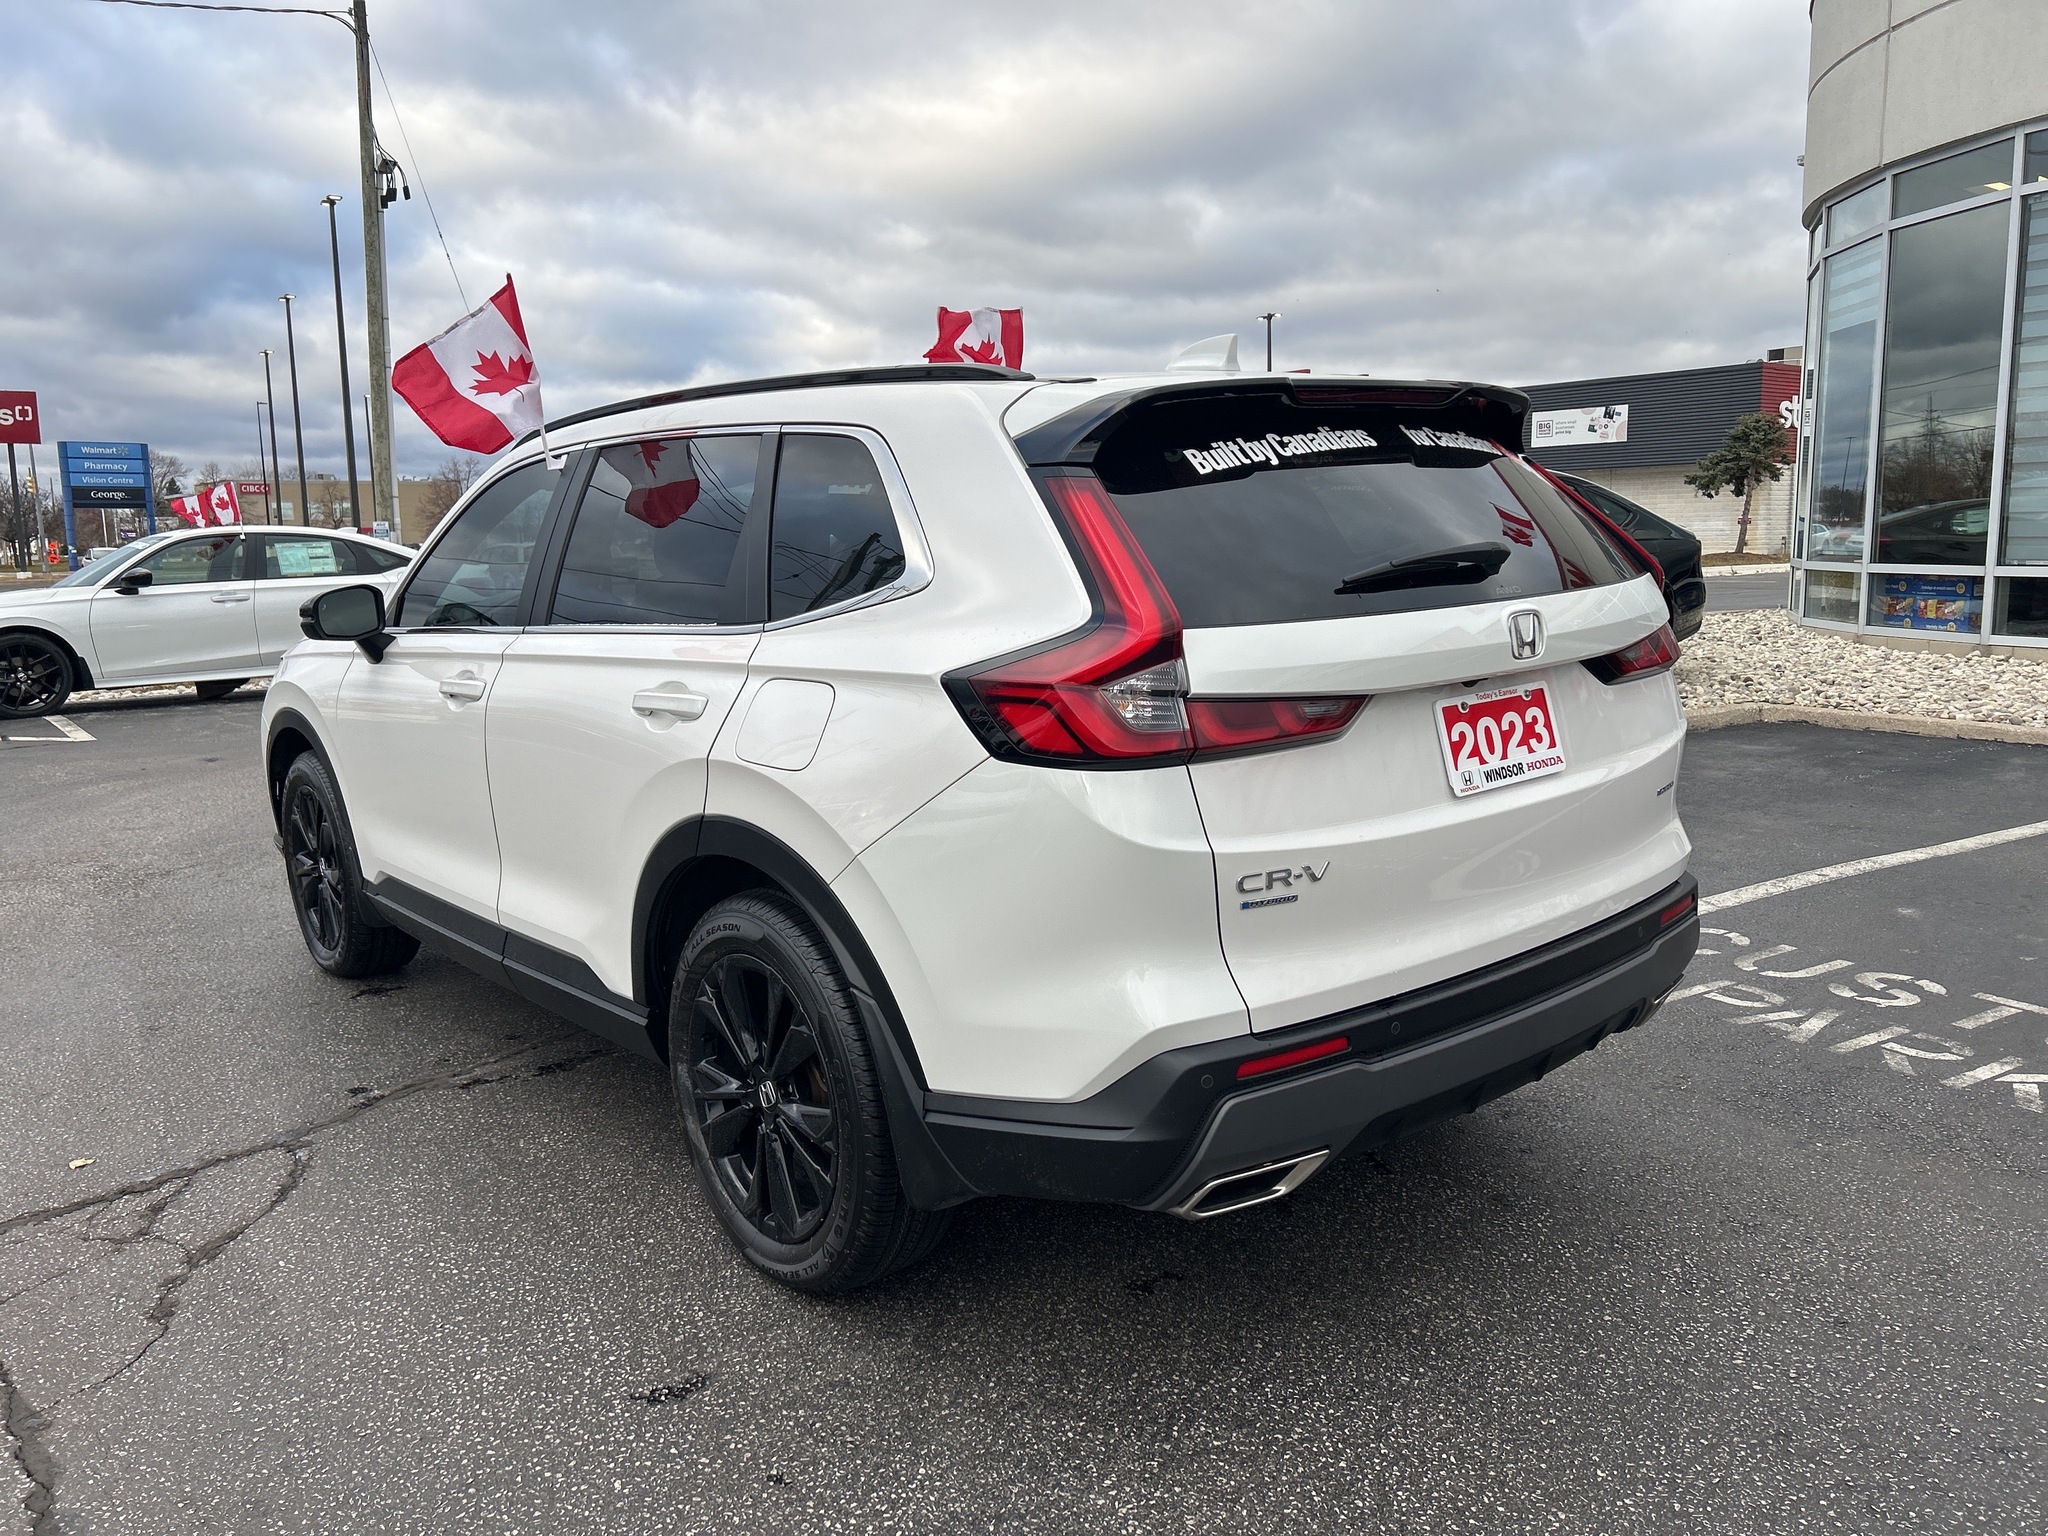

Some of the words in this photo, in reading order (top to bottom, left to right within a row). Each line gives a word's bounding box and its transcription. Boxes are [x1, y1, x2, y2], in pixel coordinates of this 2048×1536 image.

[80, 446, 117, 454] Walmart
[1398, 424, 1436, 446] for
[1422, 426, 1503, 456] Canadians
[1183, 440, 1250, 475] Built
[1236, 438, 1281, 466] by
[1266, 426, 1380, 457] Canadians
[84, 462, 128, 471] Pharmacy
[82, 476, 107, 484] Vision
[107, 476, 134, 484] Centre
[241, 484, 261, 492] CIBC
[1475, 690, 1499, 701] Today's
[1450, 706, 1551, 771] 2023
[1483, 762, 1526, 784] WINDSOR
[1526, 755, 1564, 771] HONDA
[1460, 784, 1480, 793] HONDA
[1236, 860, 1330, 894] CR-V
[690, 934, 706, 953] ALL
[706, 923, 742, 938] SEASON
